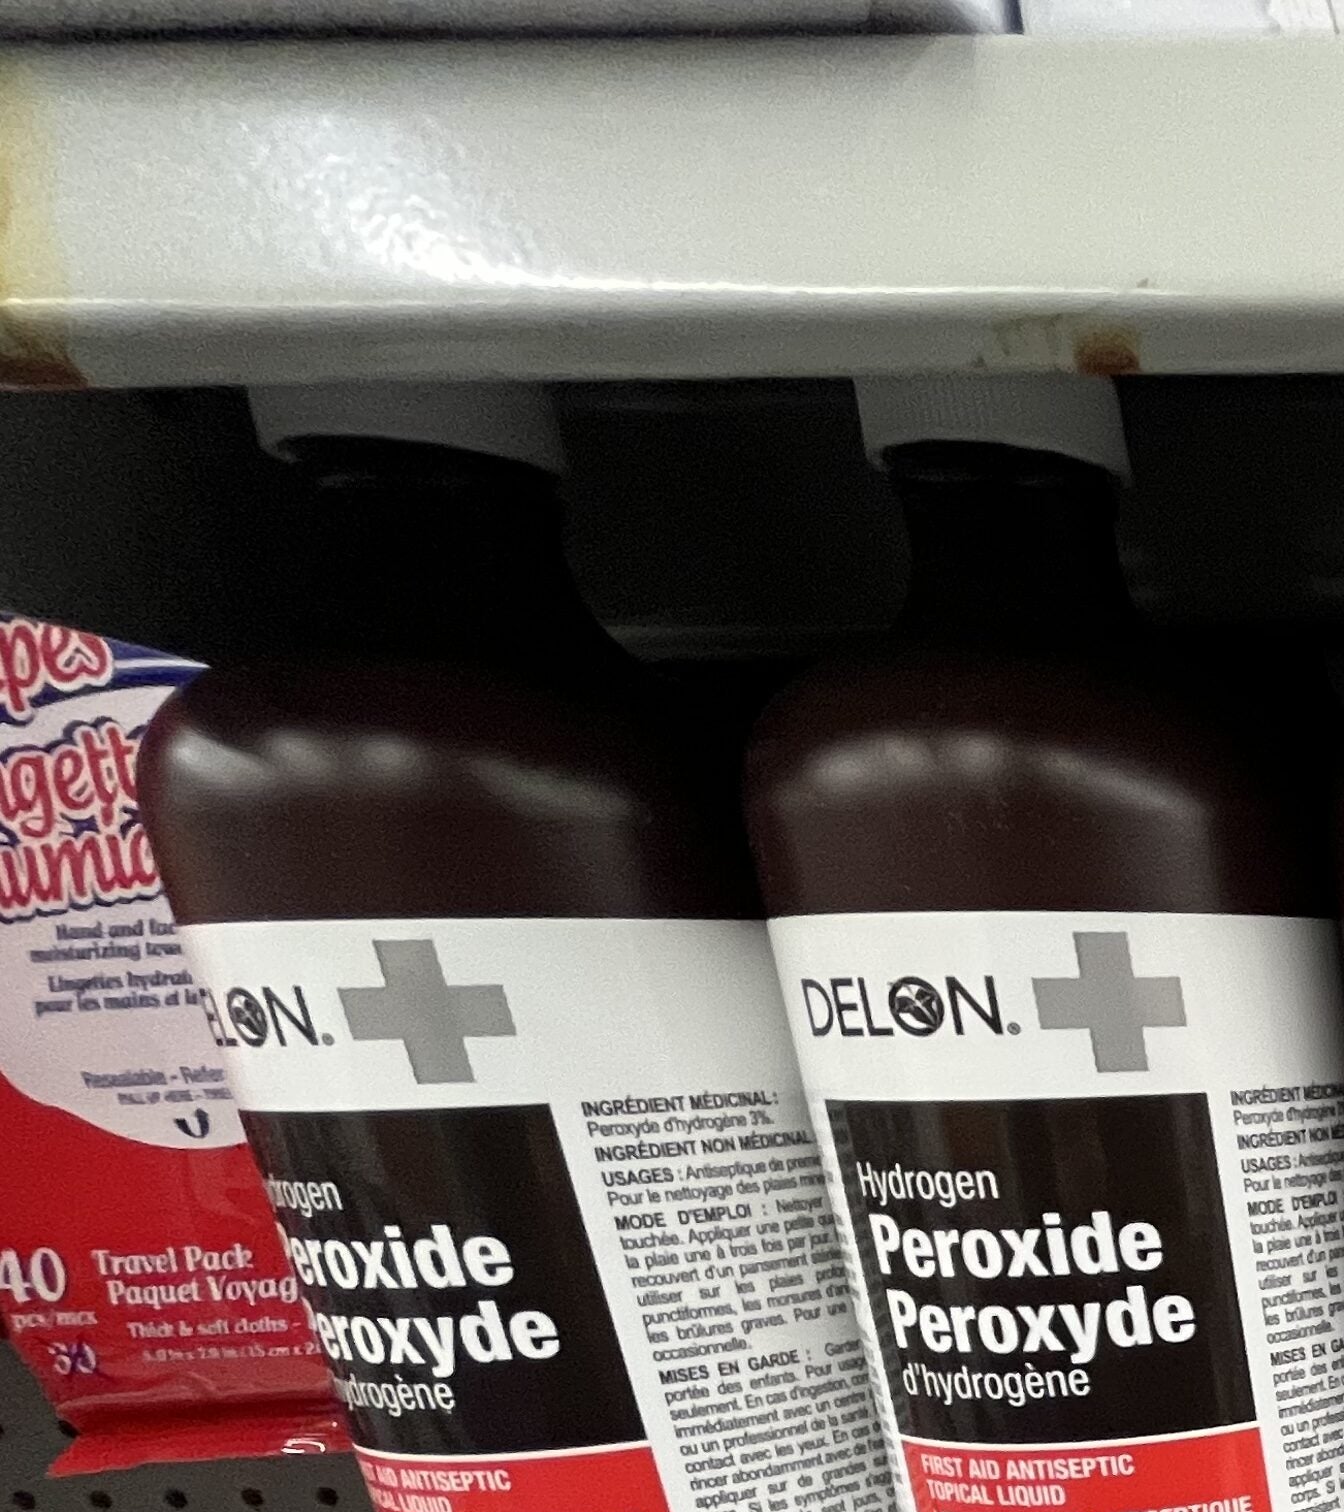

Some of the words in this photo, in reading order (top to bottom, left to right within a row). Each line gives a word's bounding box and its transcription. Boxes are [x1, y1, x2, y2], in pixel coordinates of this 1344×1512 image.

[801, 975, 1005, 1037] DELON
[601, 1167, 674, 1187] USAGES
[857, 1160, 998, 1208] Hydrogen
[0, 1247, 66, 1303] 40
[92, 1246, 178, 1276] Travel
[182, 1243, 252, 1272] Pack
[869, 1210, 1163, 1279] Peroxide
[107, 1279, 199, 1309] Paquet
[209, 1276, 297, 1305] Voyag
[886, 1286, 1196, 1364] Peroxyde
